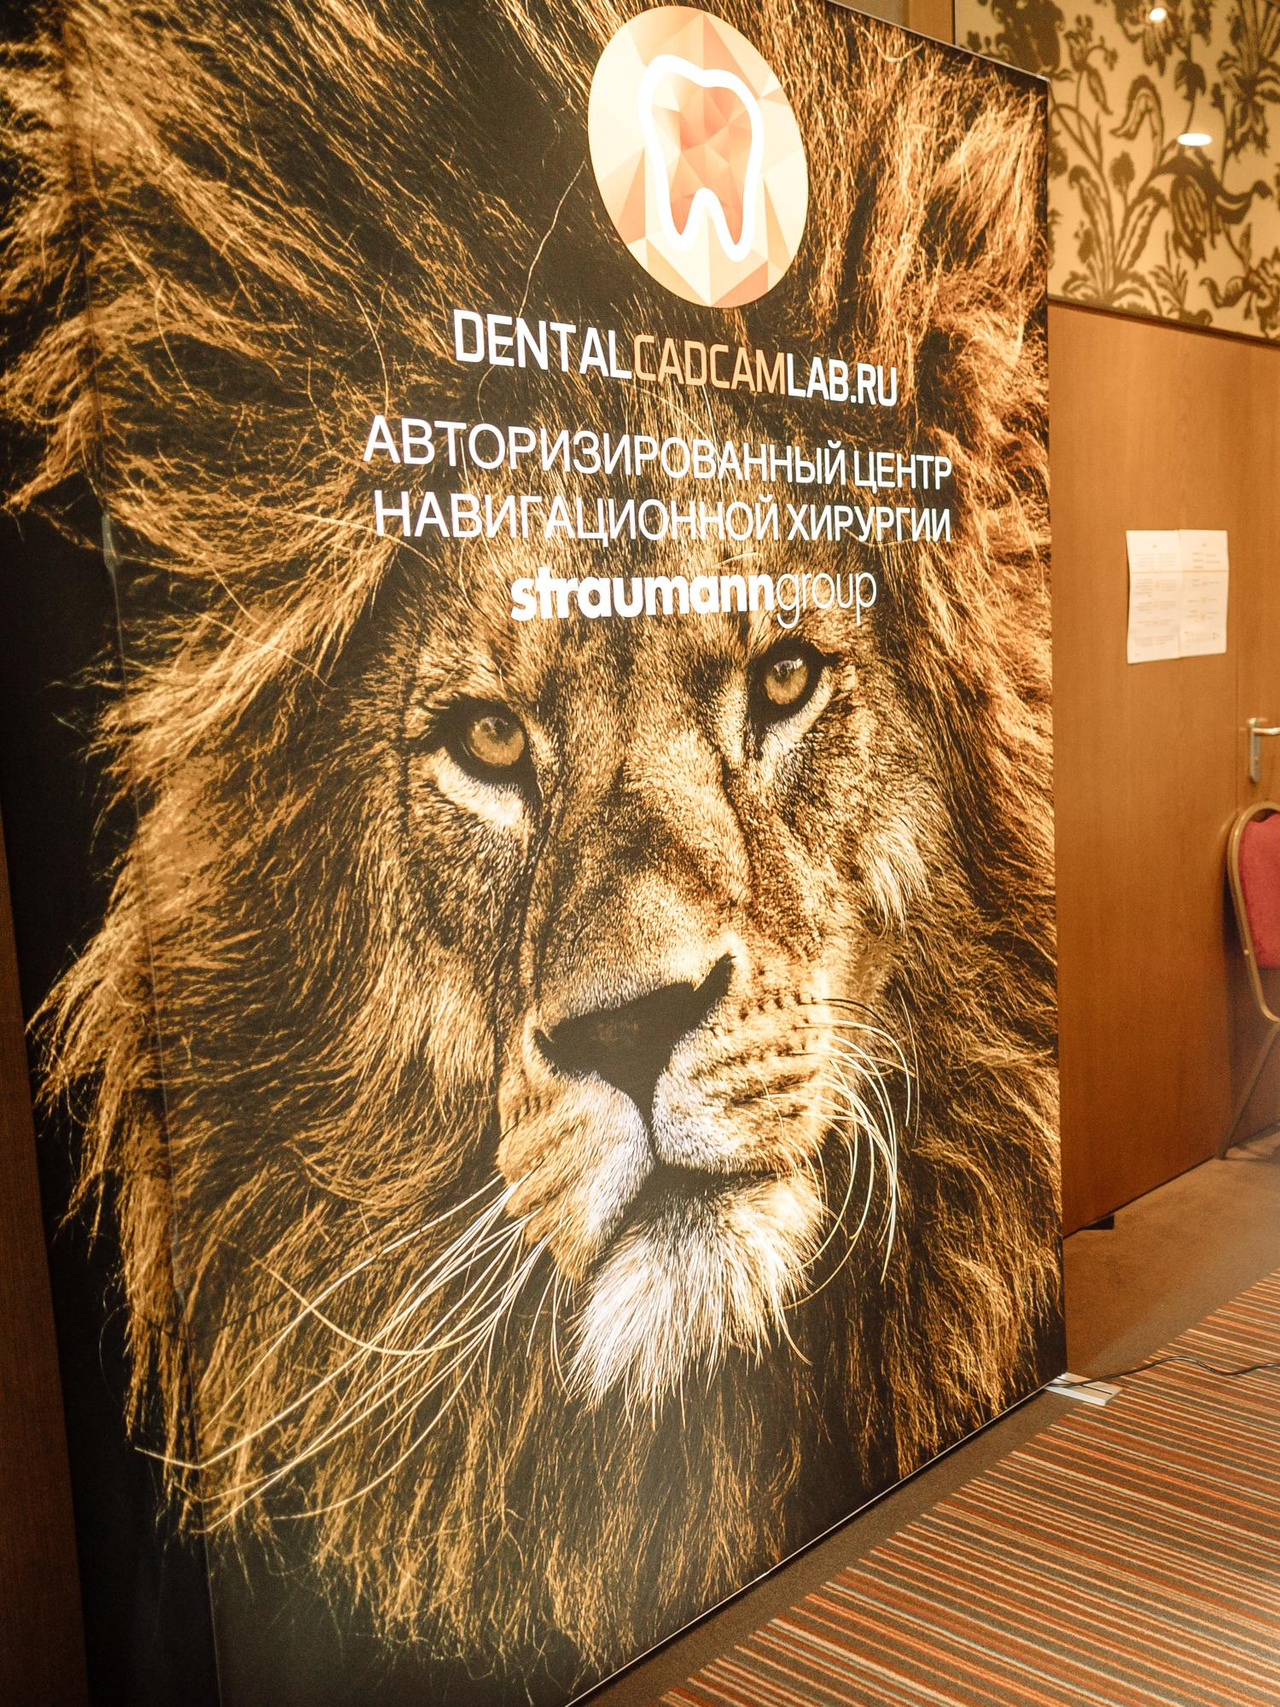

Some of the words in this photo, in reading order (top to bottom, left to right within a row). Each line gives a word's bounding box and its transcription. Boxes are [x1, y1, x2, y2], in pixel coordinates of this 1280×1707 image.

[453, 308, 898, 408] DENTALCADCAMLAB.RU
[362, 414, 847, 484] АВТОРИЗИРОВАННЫЙ
[853, 448, 953, 491] ЦЕНТР
[373, 489, 781, 547] НАВИГАЦИОННОЙ
[787, 503, 952, 543] ХИРУРГИИ
[510, 566, 878, 630] straumanngroup
